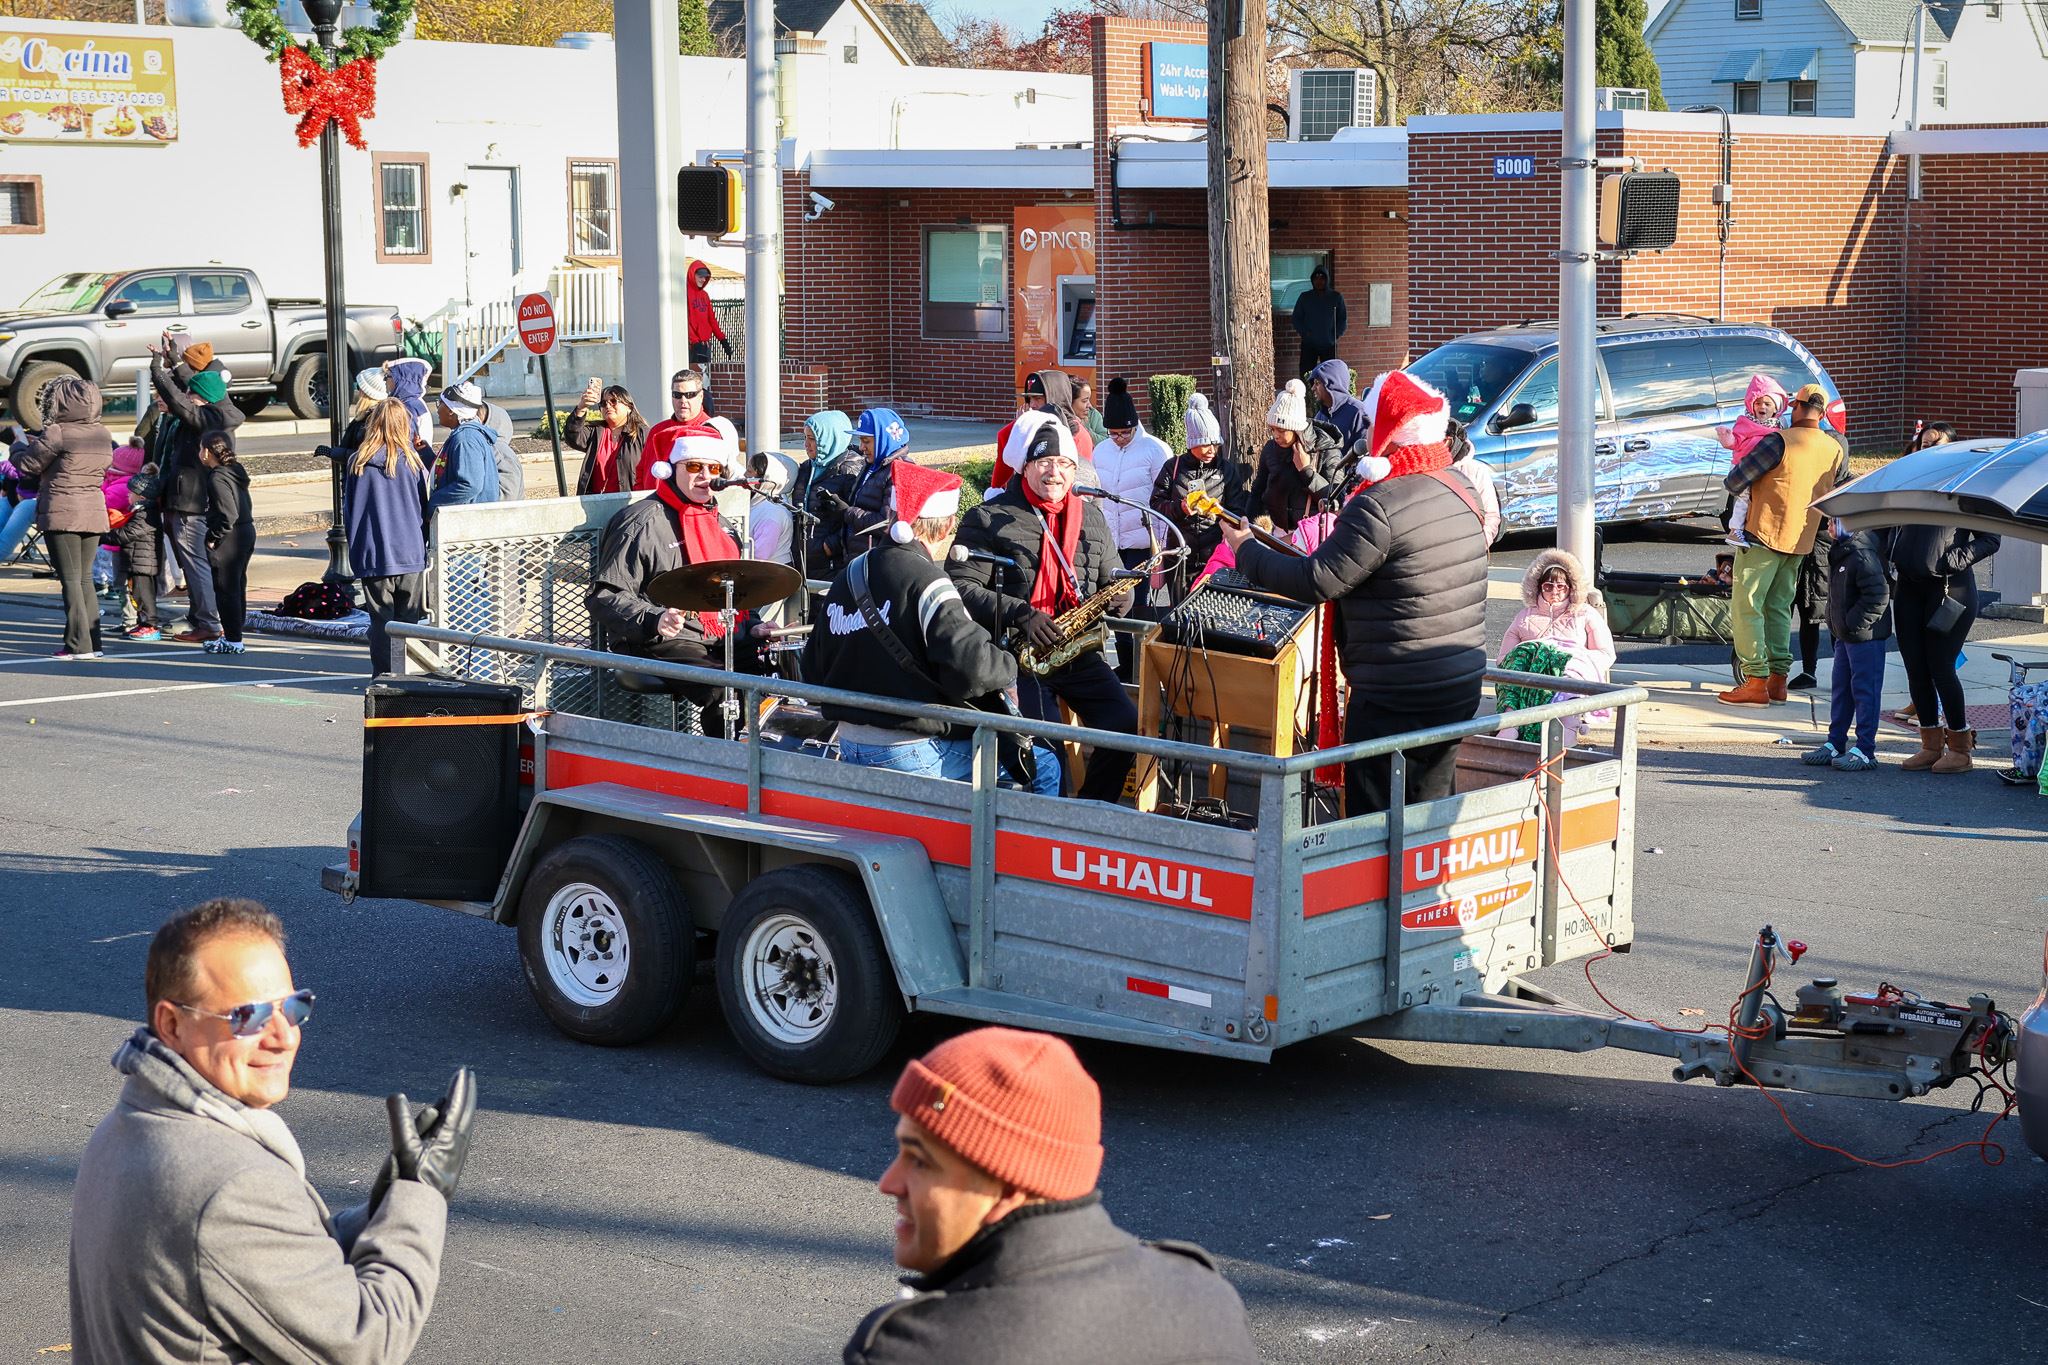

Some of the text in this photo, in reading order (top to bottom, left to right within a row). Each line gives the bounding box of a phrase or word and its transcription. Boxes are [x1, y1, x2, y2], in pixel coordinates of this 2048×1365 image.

[1160, 63, 1182, 77] 24hr
[1160, 83, 1201, 101] Walk-Up
[1496, 158, 1531, 175] 5000
[1039, 231, 1095, 250] PNCB
[522, 303, 546, 317] DO NOT
[527, 331, 550, 344] ENTER
[1416, 829, 1524, 881] U-HAUL
[1052, 847, 1213, 907] U-HAUL
[1416, 888, 1519, 924] FINEST SAFEST
[1564, 920, 1578, 937] HO
[1899, 1012, 1962, 1028] HYDRAULIC BRAKES
[1915, 1009, 1946, 1018] AUTOMATIC
